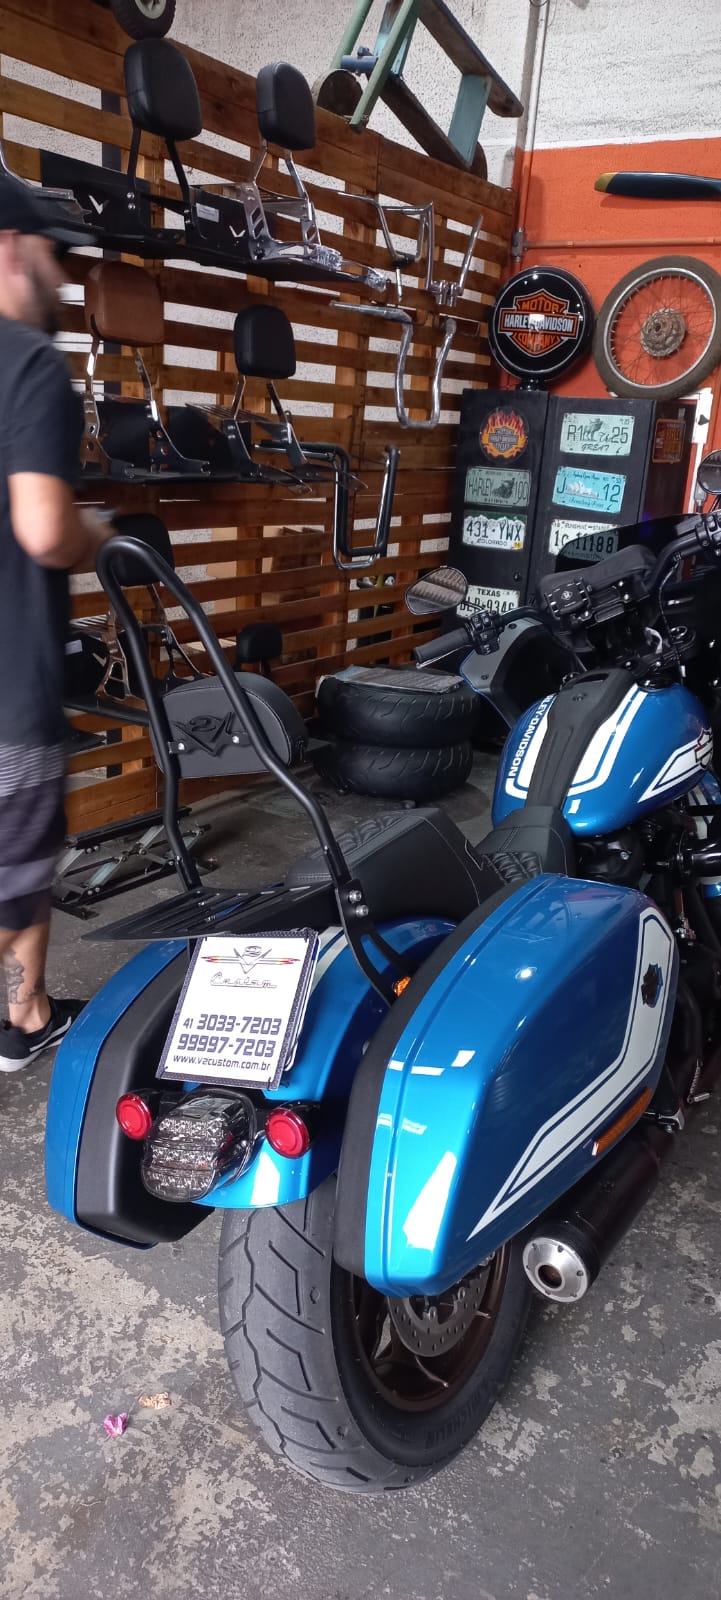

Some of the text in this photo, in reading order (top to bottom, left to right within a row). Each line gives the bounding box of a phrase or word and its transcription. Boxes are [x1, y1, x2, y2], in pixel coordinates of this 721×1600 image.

[521, 299, 560, 314] MOTOR
[503, 313, 574, 334] HARLEYDAVIDSON
[517, 332, 555, 350] COMPANY
[603, 483, 621, 503] 12
[477, 588, 501, 598] TEXAS
[182, 1013, 282, 1036] 41 3033-7203
[177, 1033, 276, 1058] 99997-7203
[173, 1054, 271, 1071] www.v2custom.com.br
